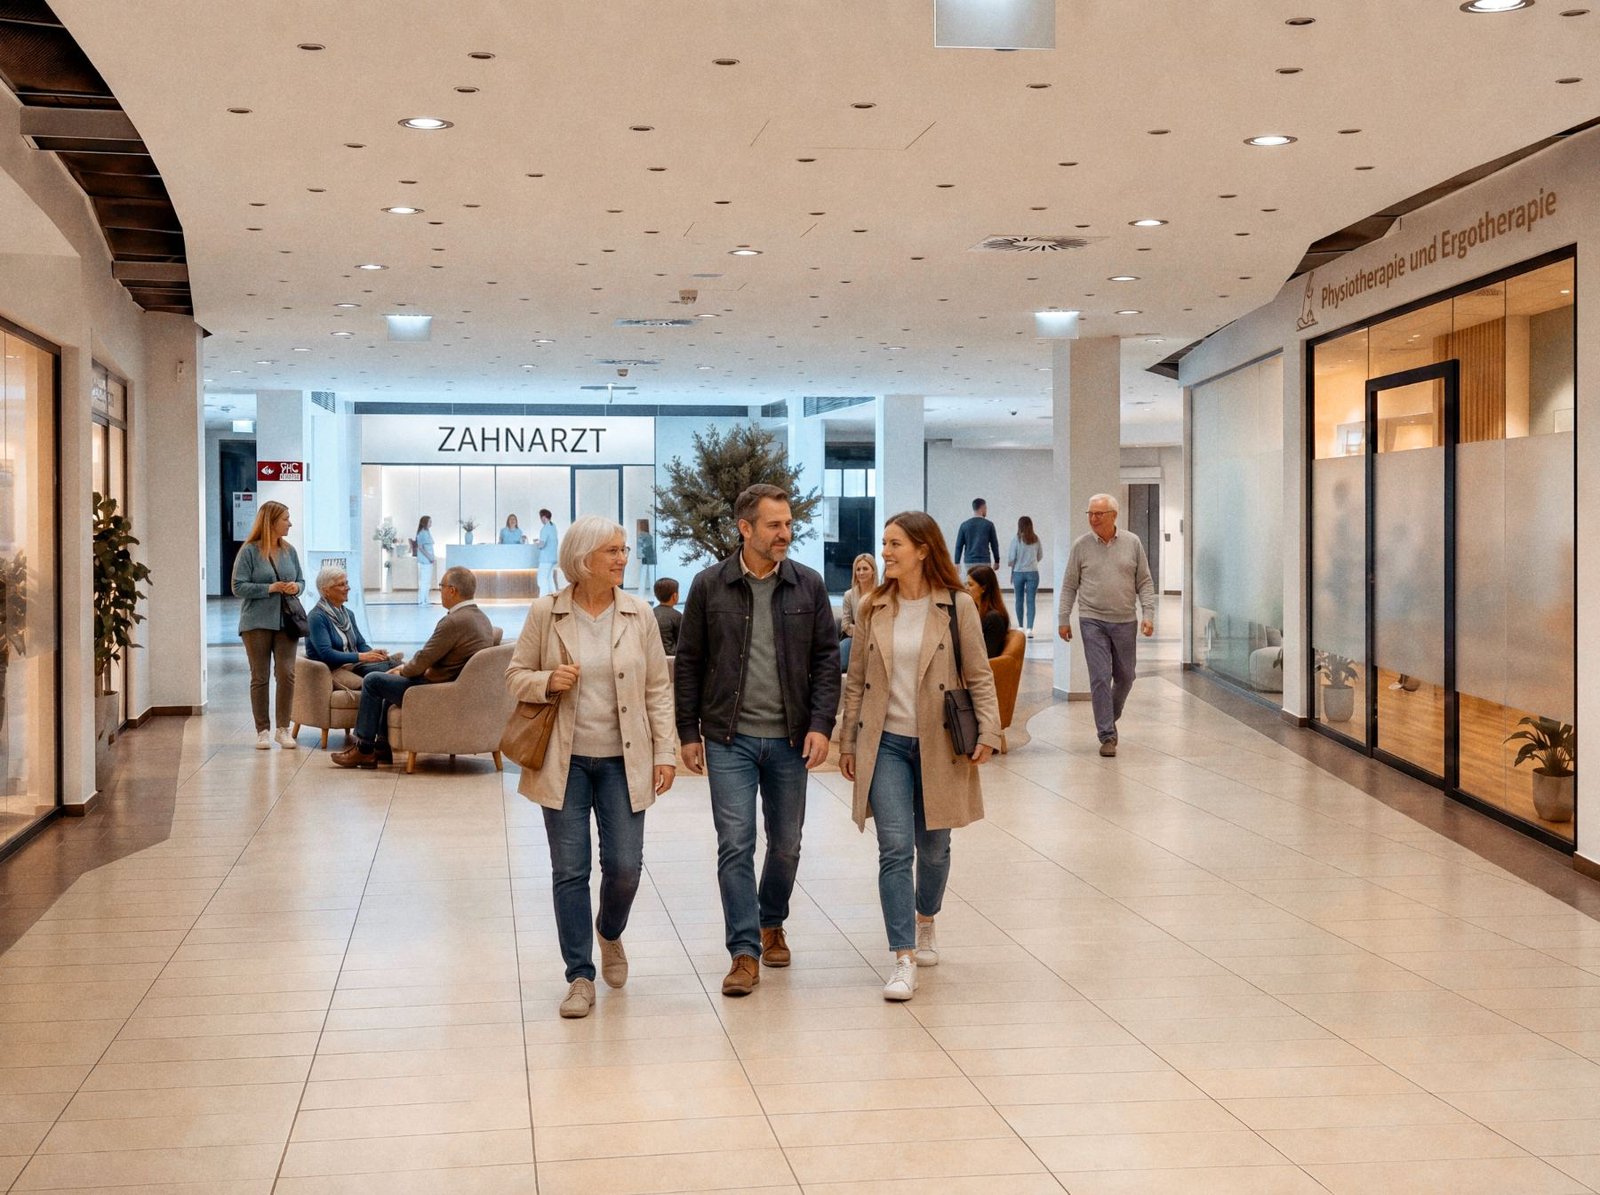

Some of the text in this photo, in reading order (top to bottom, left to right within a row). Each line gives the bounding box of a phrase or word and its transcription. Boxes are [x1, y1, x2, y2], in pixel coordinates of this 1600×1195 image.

[1321, 188, 1557, 310] Physiotherapie und Ergotherapie
[438, 426, 607, 453] ZAHNARZT
